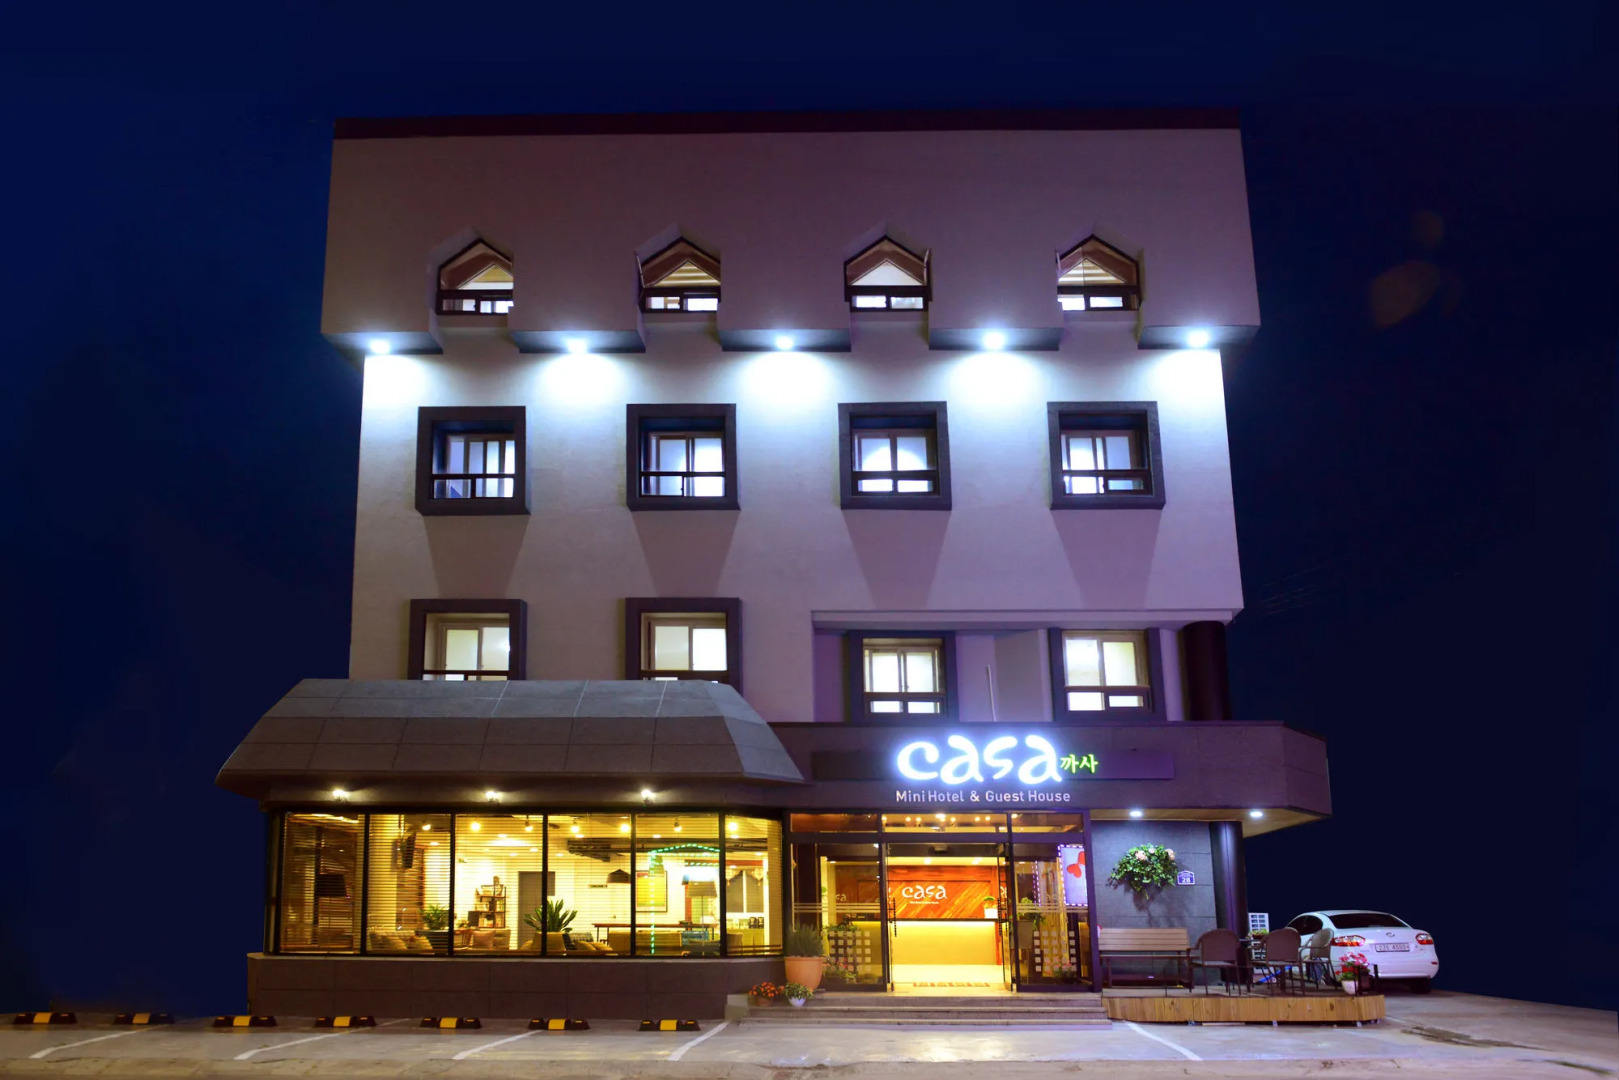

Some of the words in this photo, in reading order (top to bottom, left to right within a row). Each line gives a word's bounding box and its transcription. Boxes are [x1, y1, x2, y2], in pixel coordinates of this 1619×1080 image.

[896, 734, 1063, 785] casa
[1060, 753, 1099, 774] 까사
[896, 790, 926, 802] Mini
[928, 790, 964, 802] Hotel
[970, 790, 980, 802] &
[985, 790, 1024, 802] Guest
[1028, 790, 1071, 802] House
[901, 885, 948, 900] casa
